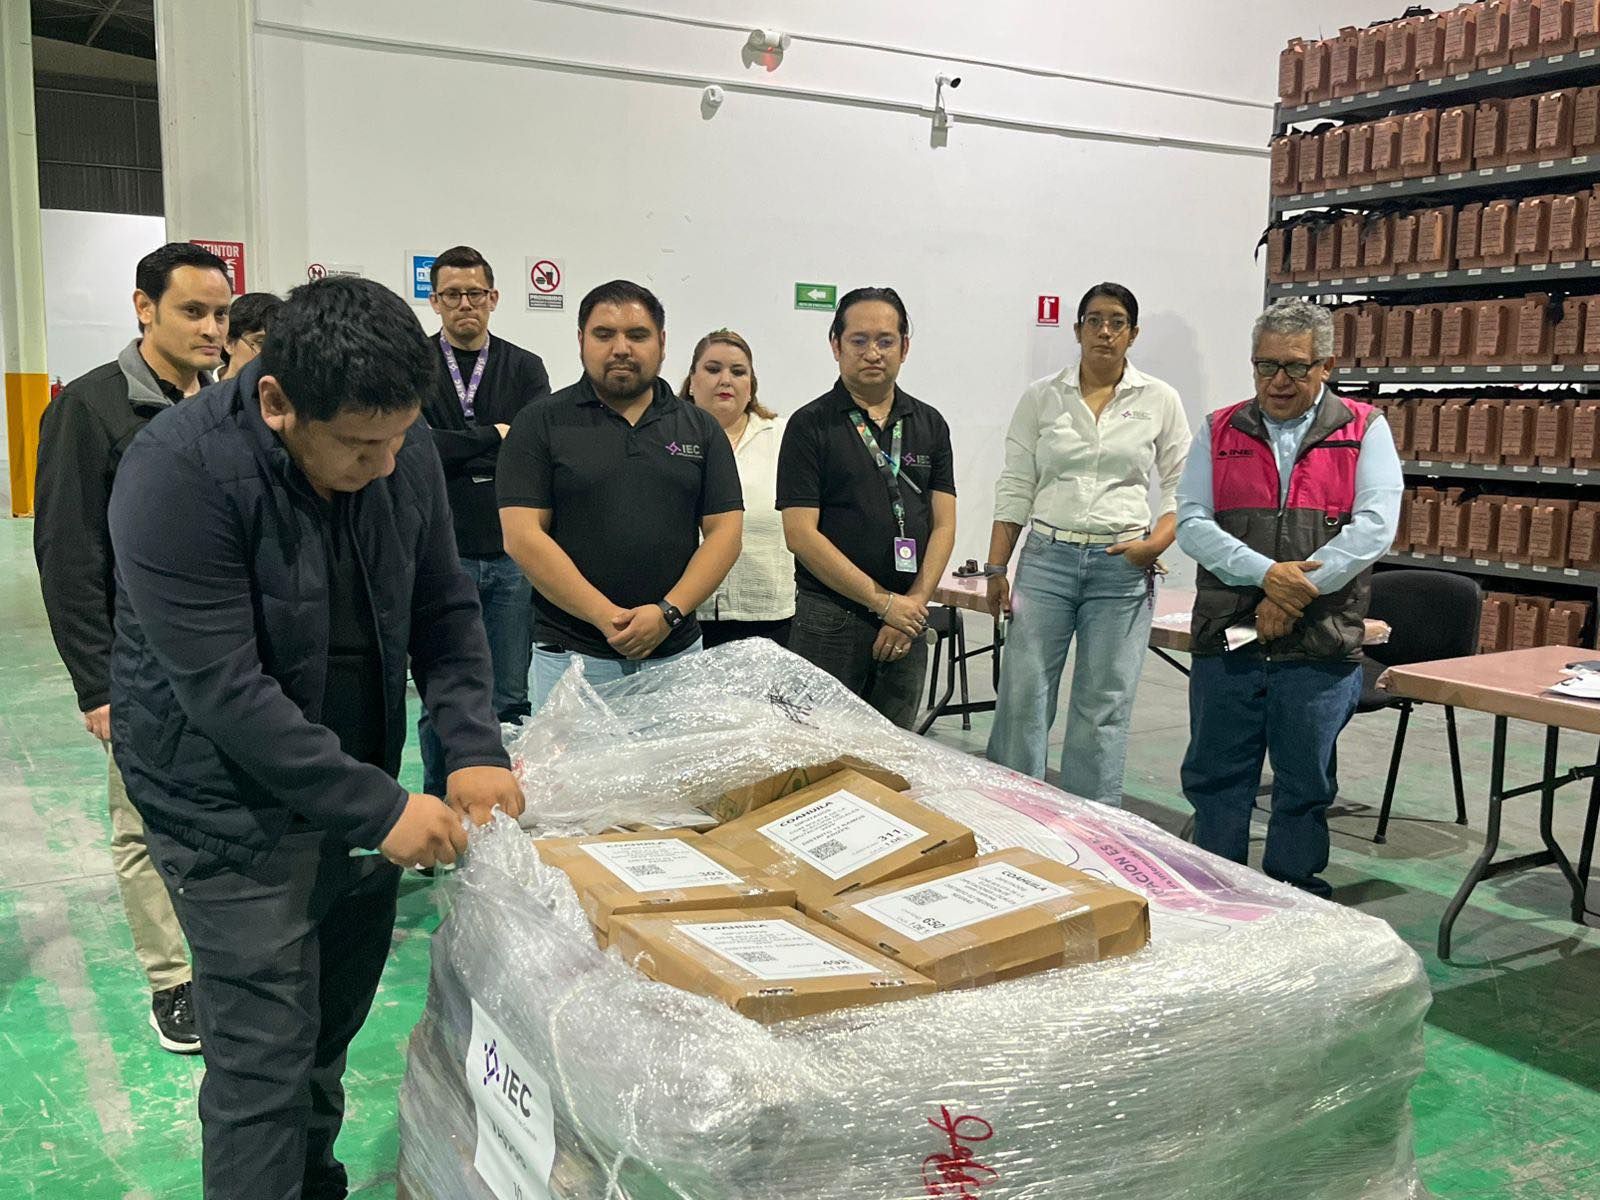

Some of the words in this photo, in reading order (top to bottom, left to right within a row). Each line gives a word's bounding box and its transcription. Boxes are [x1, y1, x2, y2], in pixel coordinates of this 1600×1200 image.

[681, 443, 700, 454] IEC
[778, 801, 834, 827] COAHUILA
[877, 828, 901, 841] 311
[1001, 870, 1048, 892] COAHUILA
[921, 916, 946, 929] 650
[502, 1063, 533, 1119] IEC
